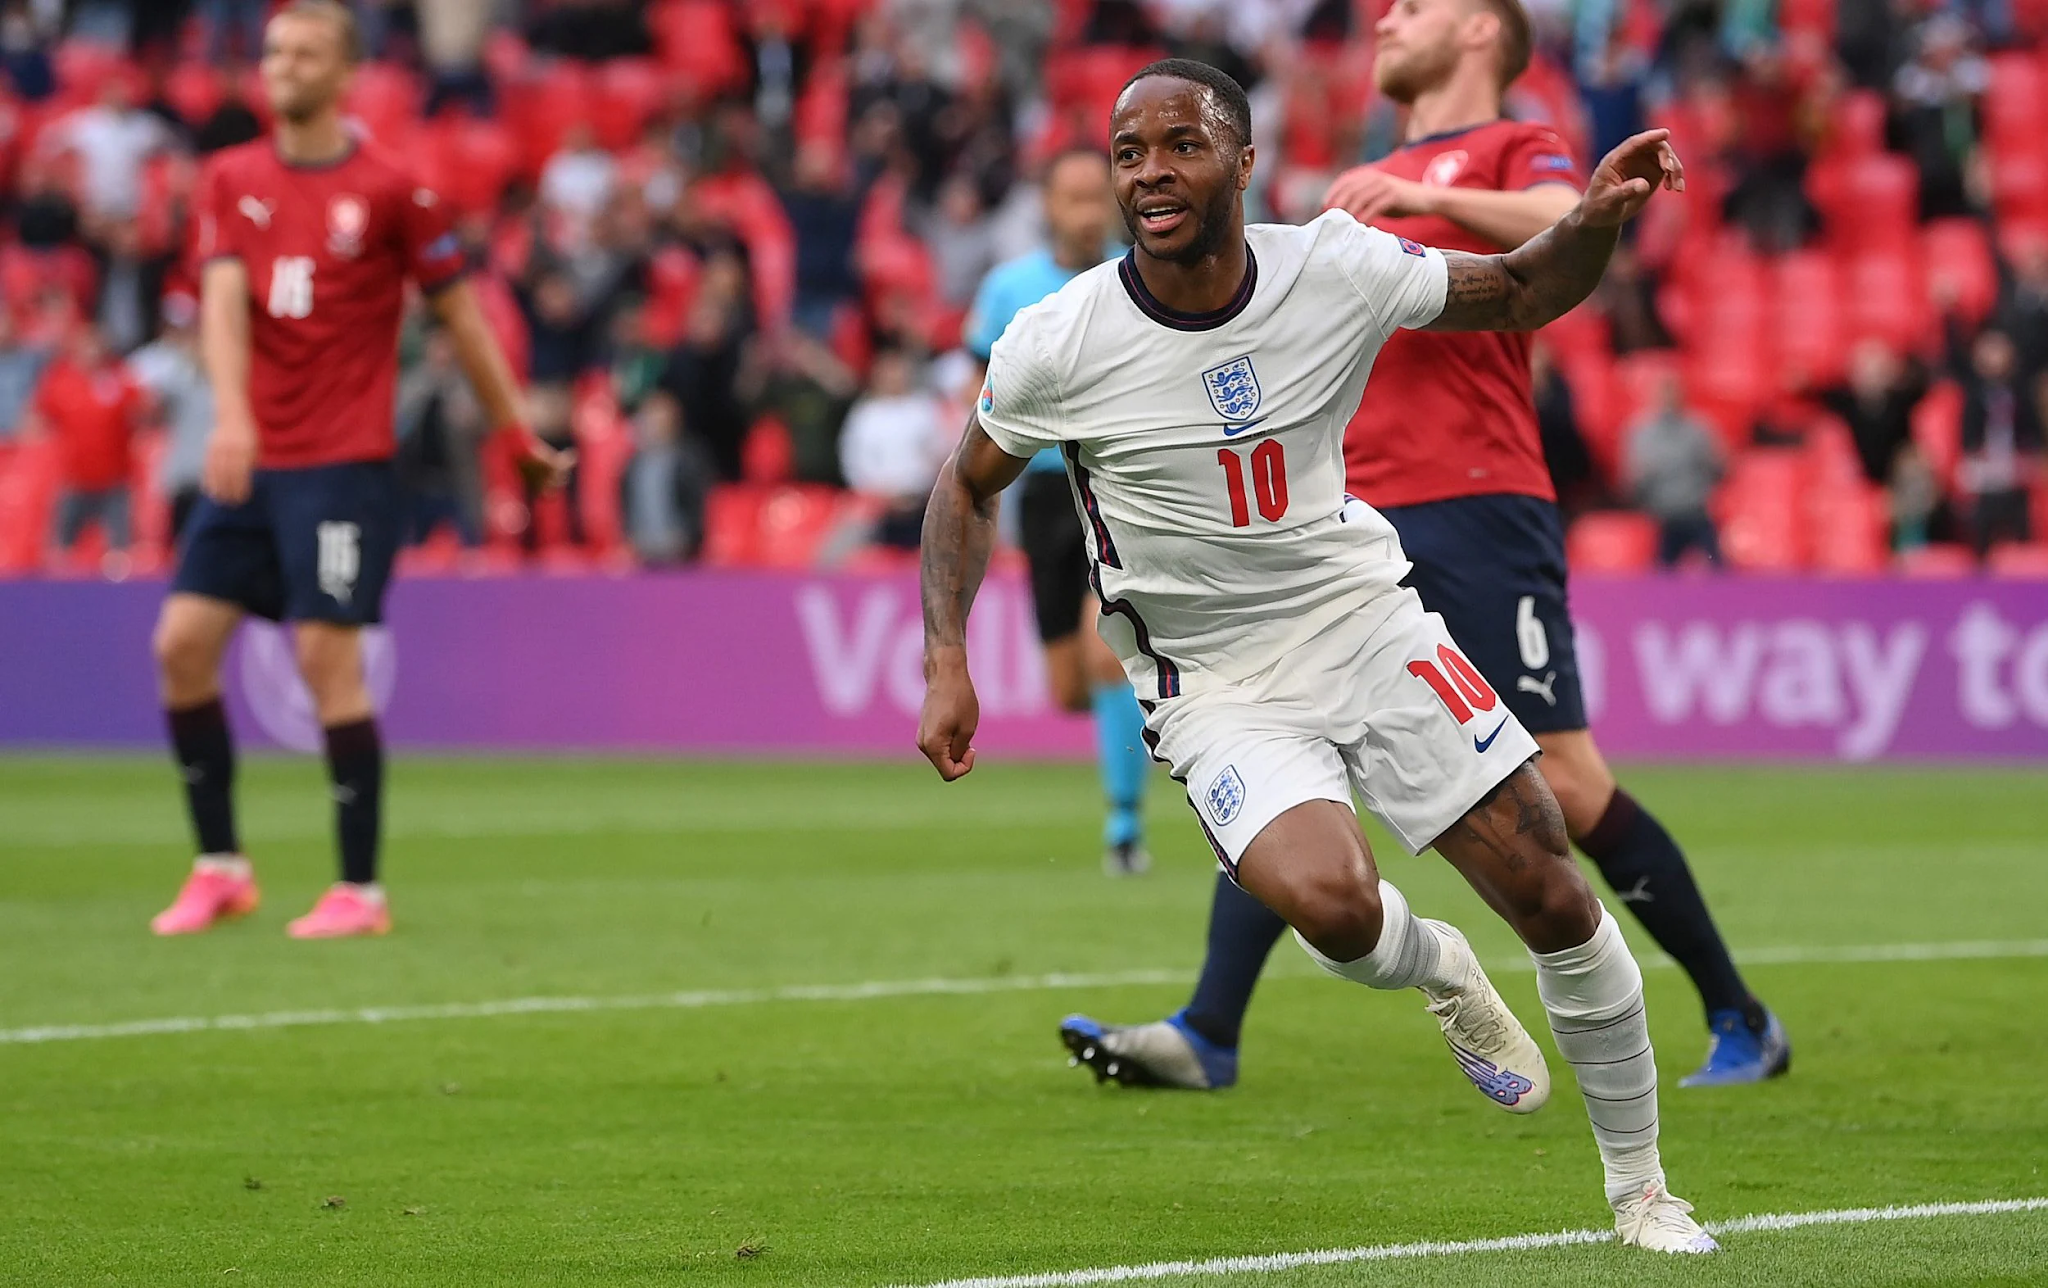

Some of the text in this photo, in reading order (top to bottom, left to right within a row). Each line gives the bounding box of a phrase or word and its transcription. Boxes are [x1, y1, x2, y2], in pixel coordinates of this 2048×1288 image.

[1217, 438, 1289, 527] 10
[1516, 595, 1549, 670] 6
[1406, 643, 1496, 725] 10
[1632, 616, 1930, 760] way
